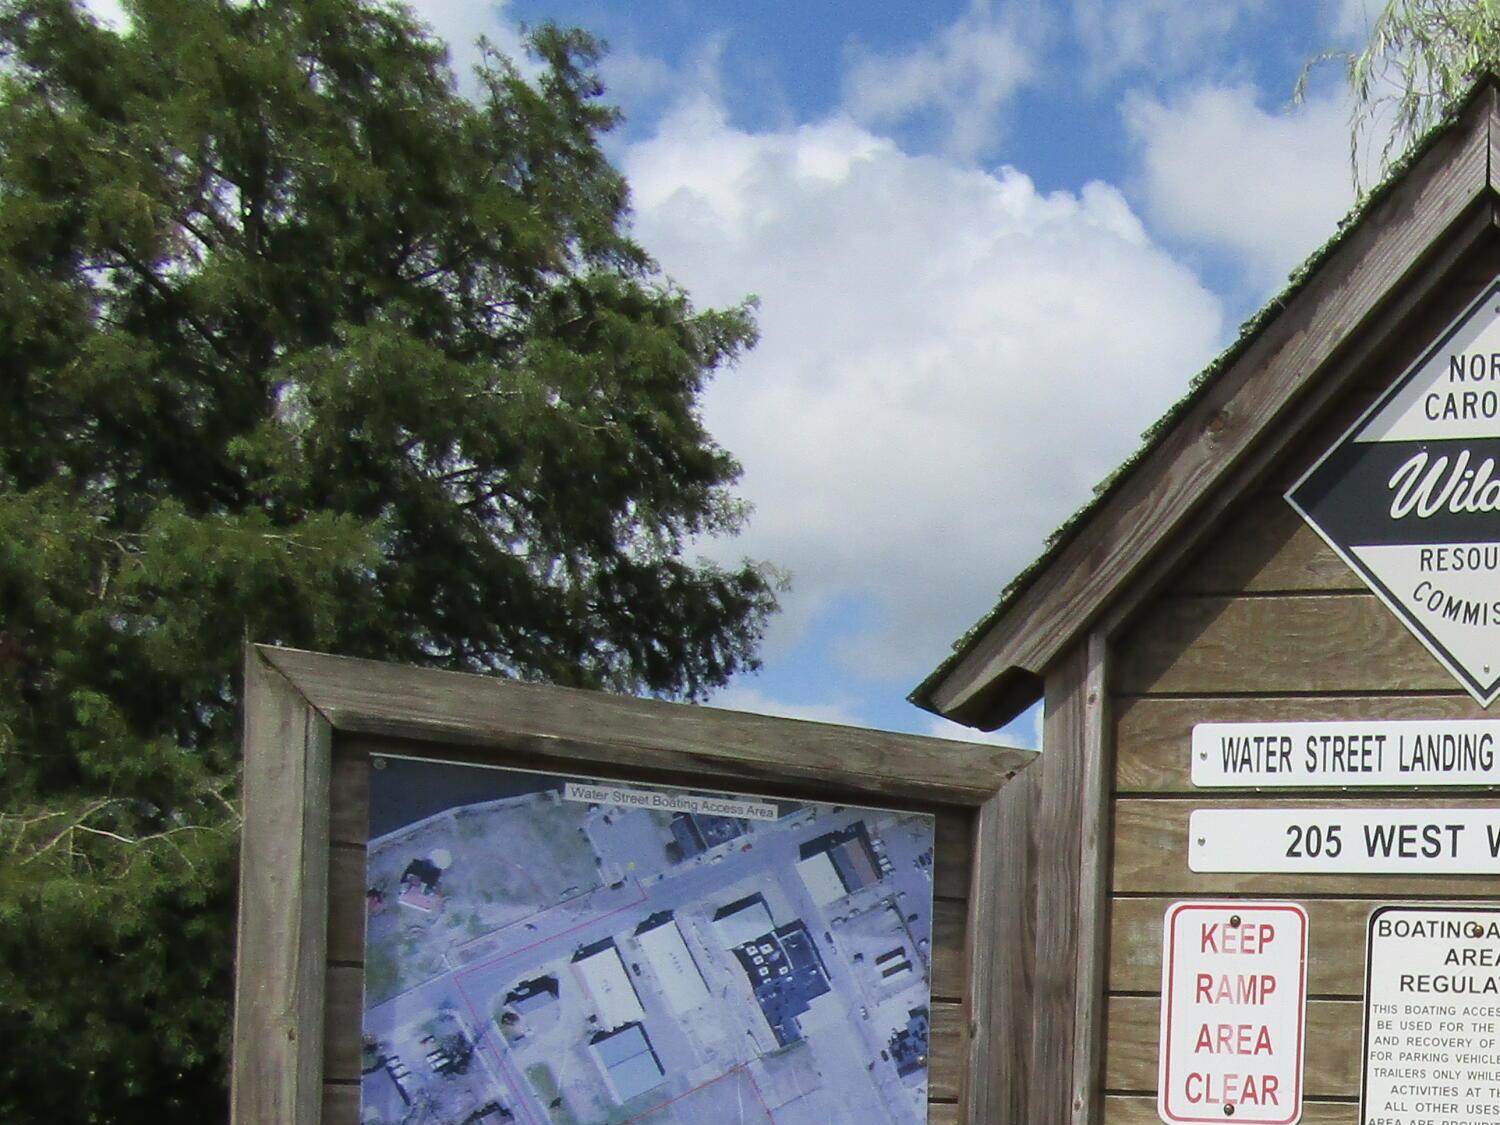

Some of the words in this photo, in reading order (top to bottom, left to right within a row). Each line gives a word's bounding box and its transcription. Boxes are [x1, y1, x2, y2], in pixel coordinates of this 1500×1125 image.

[1222, 737, 1292, 773] WATER
[1305, 736, 1386, 772] STREET
[1400, 734, 1493, 772] LANDING
[571, 788, 608, 799] Water
[613, 792, 649, 805] Street
[653, 796, 698, 811] Boating
[700, 803, 744, 815] Access
[747, 807, 773, 818] Area
[1286, 825, 1341, 857] 205
[1364, 825, 1464, 858] WEST
[1201, 924, 1275, 954] KEEP
[1196, 974, 1276, 1005] RAMP
[1195, 1024, 1273, 1055] AREA
[1185, 1073, 1279, 1105] CLEAR
